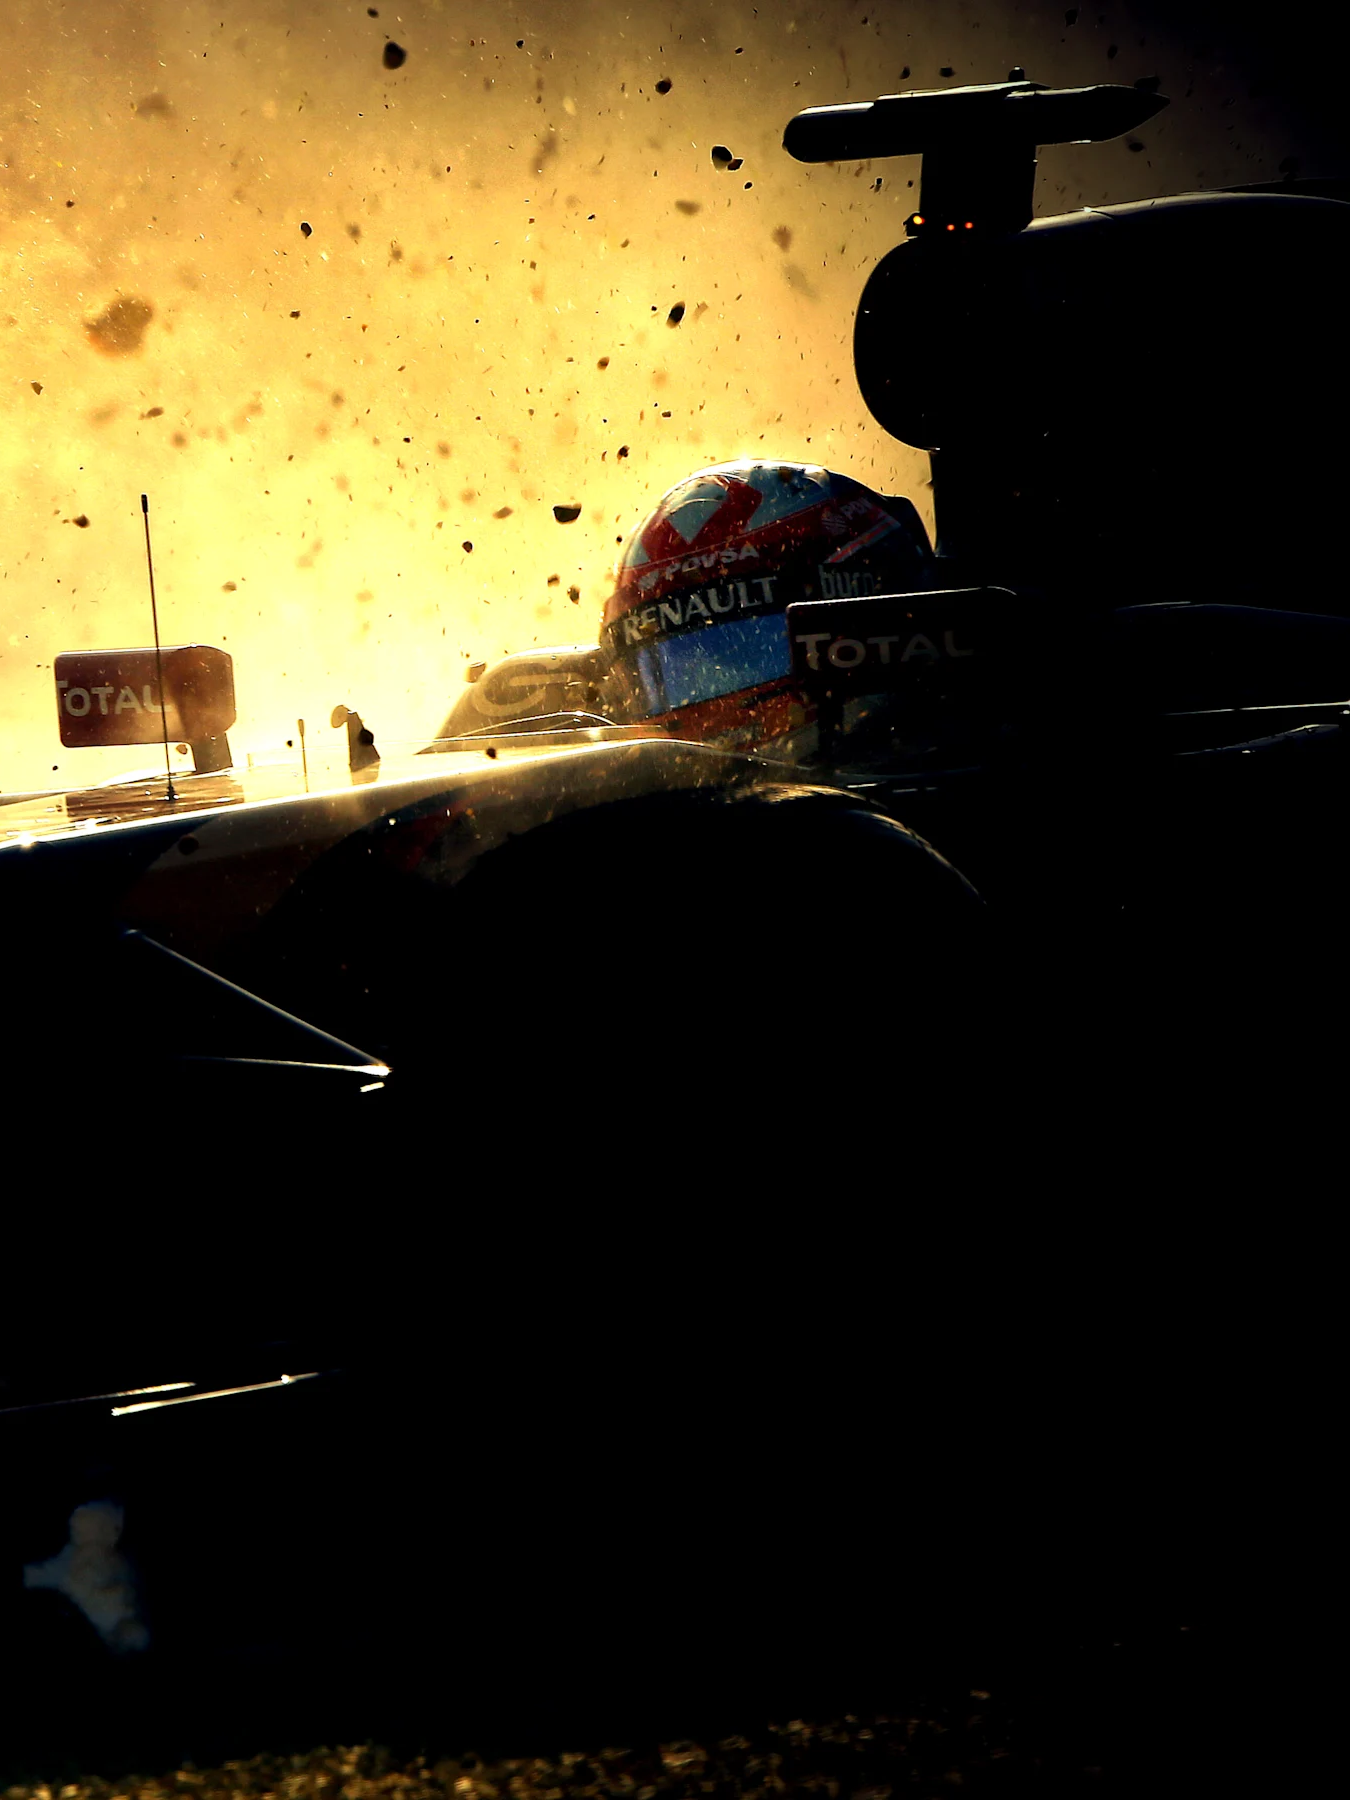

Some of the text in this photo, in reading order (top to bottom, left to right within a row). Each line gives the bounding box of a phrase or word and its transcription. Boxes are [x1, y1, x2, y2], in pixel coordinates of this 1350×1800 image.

[664, 544, 760, 581] PDVSA
[818, 563, 875, 598] burn
[623, 575, 778, 645] RENAULT
[795, 629, 975, 671] TOTAL
